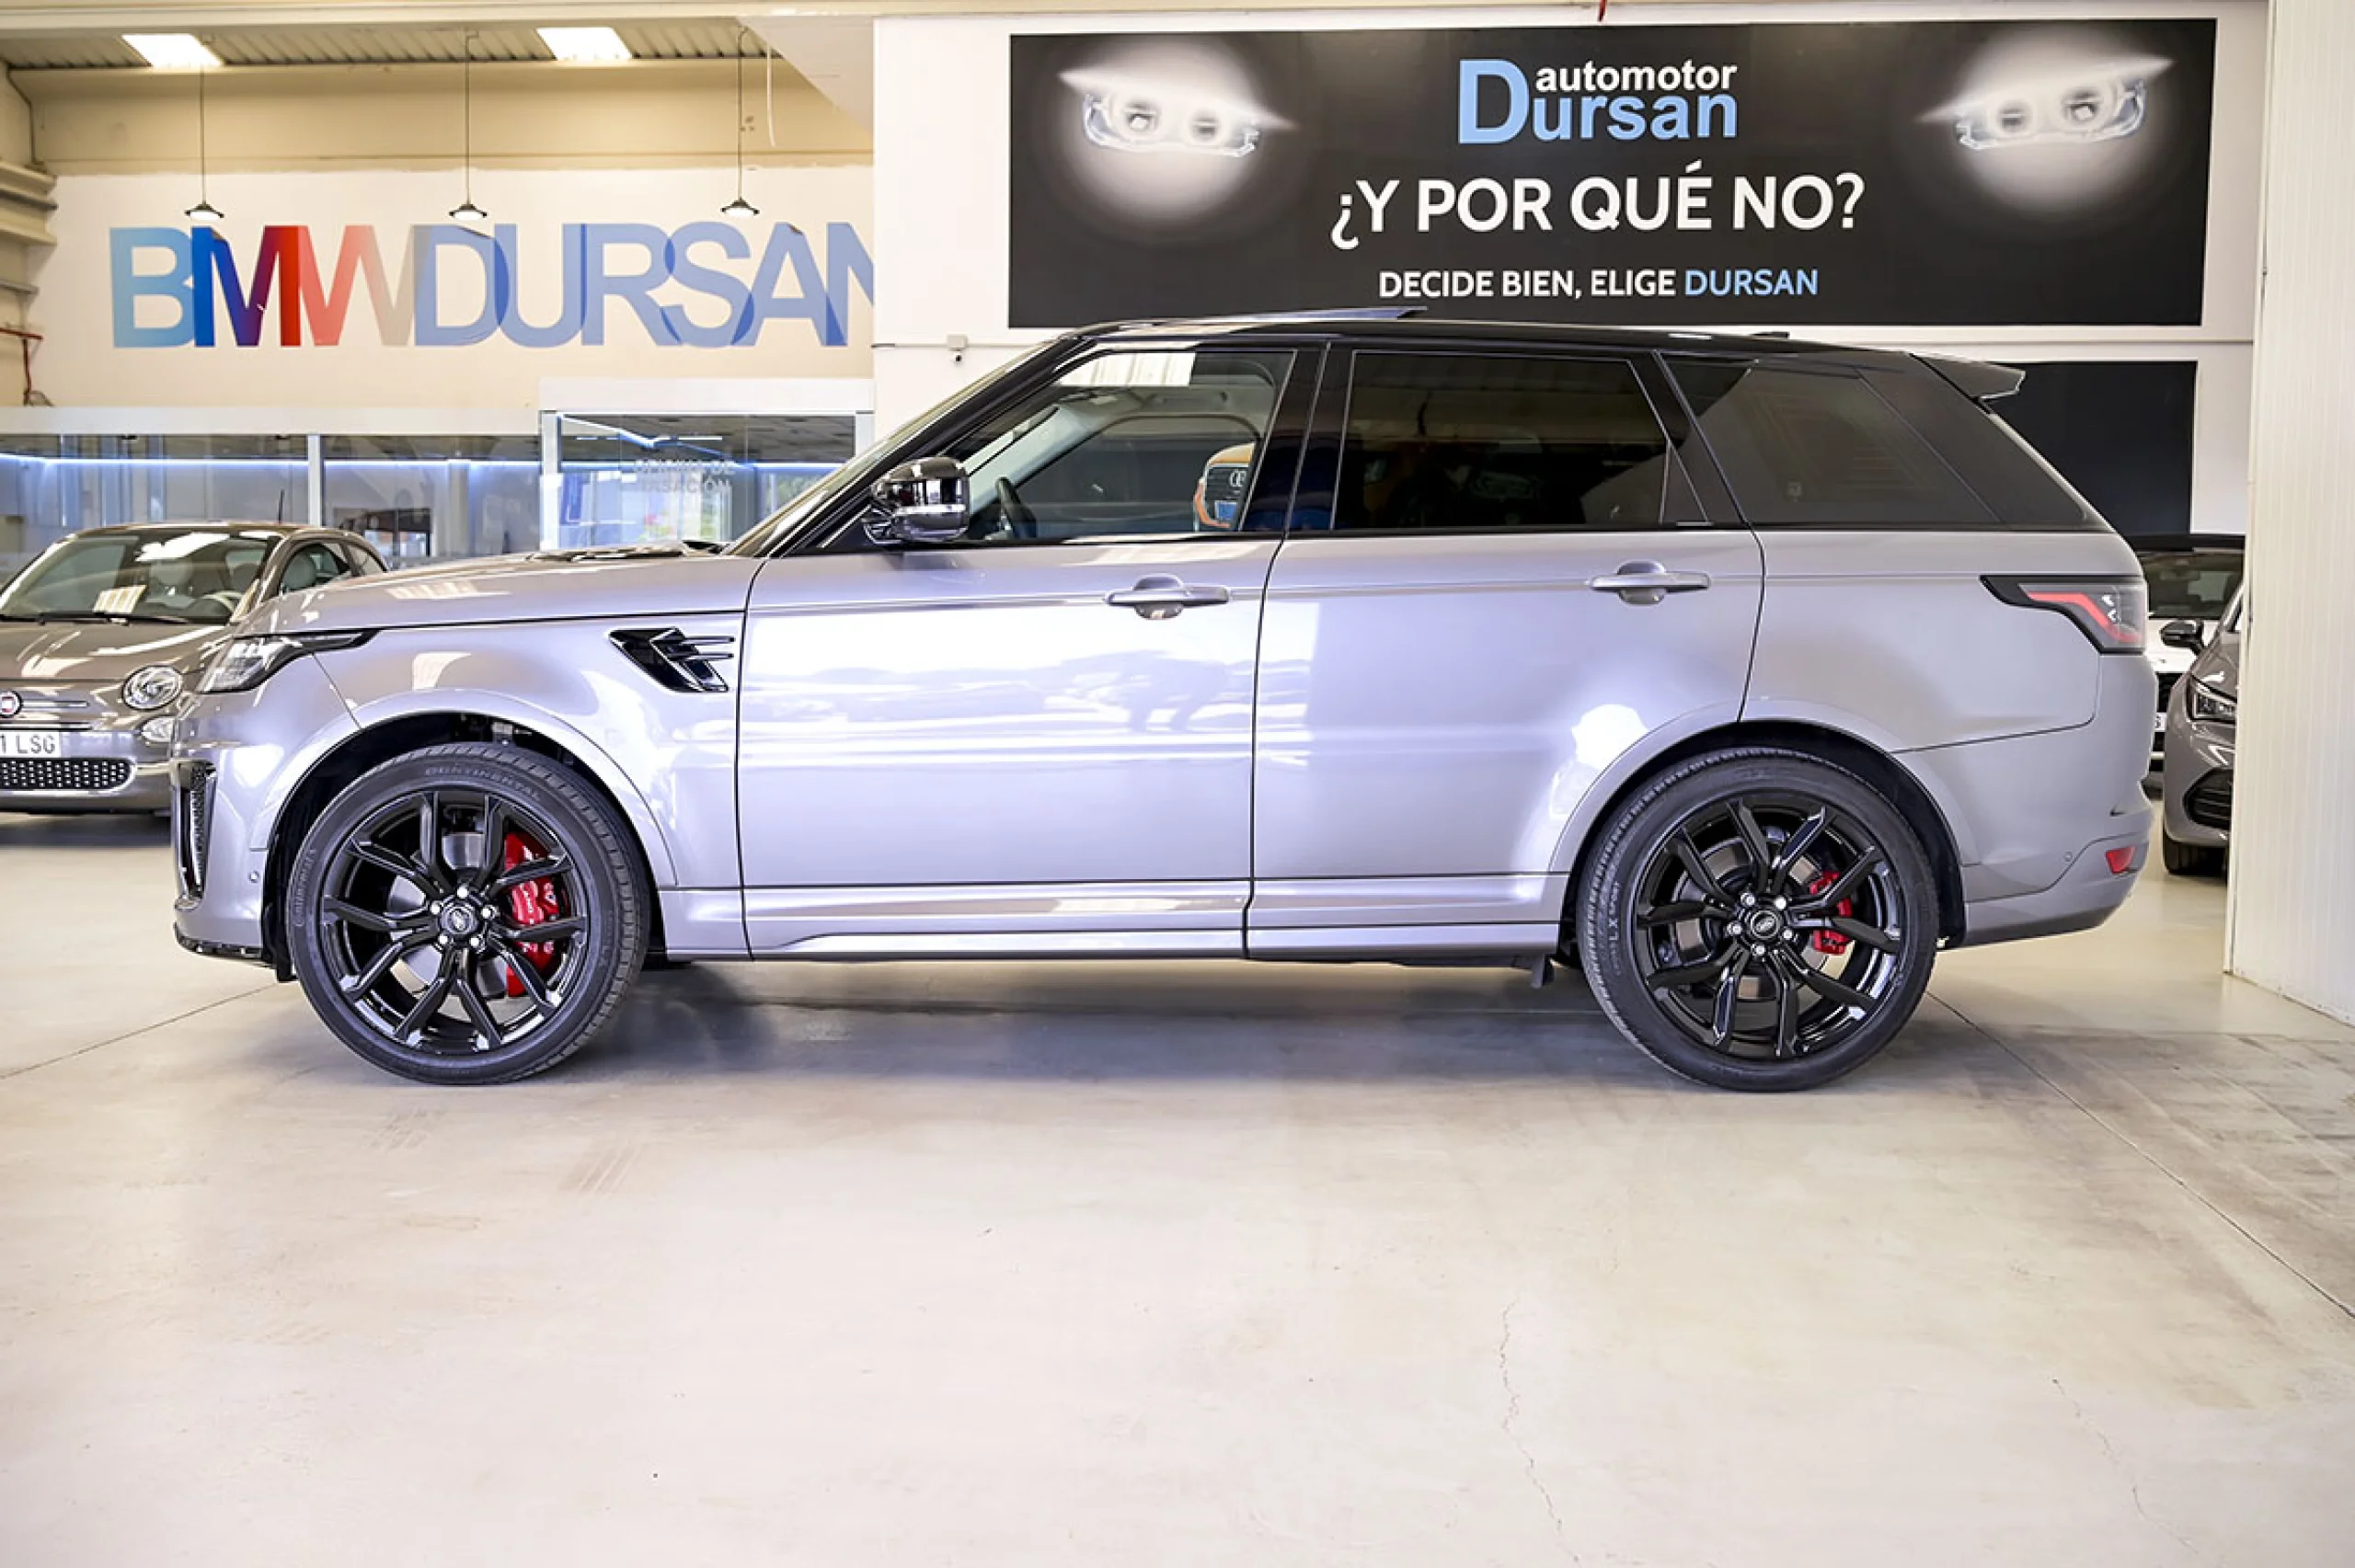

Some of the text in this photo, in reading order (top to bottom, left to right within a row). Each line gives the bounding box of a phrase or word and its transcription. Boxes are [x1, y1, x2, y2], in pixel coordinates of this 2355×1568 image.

[1535, 60, 1738, 93] automotor
[1458, 58, 1738, 144] Dursan
[1330, 159, 1866, 250] ¿Y POR QUÉ NO?
[1380, 268, 1819, 300] DECIDE BIEN, ELIGE DURSAN
[16, 734, 55, 754] LSG
